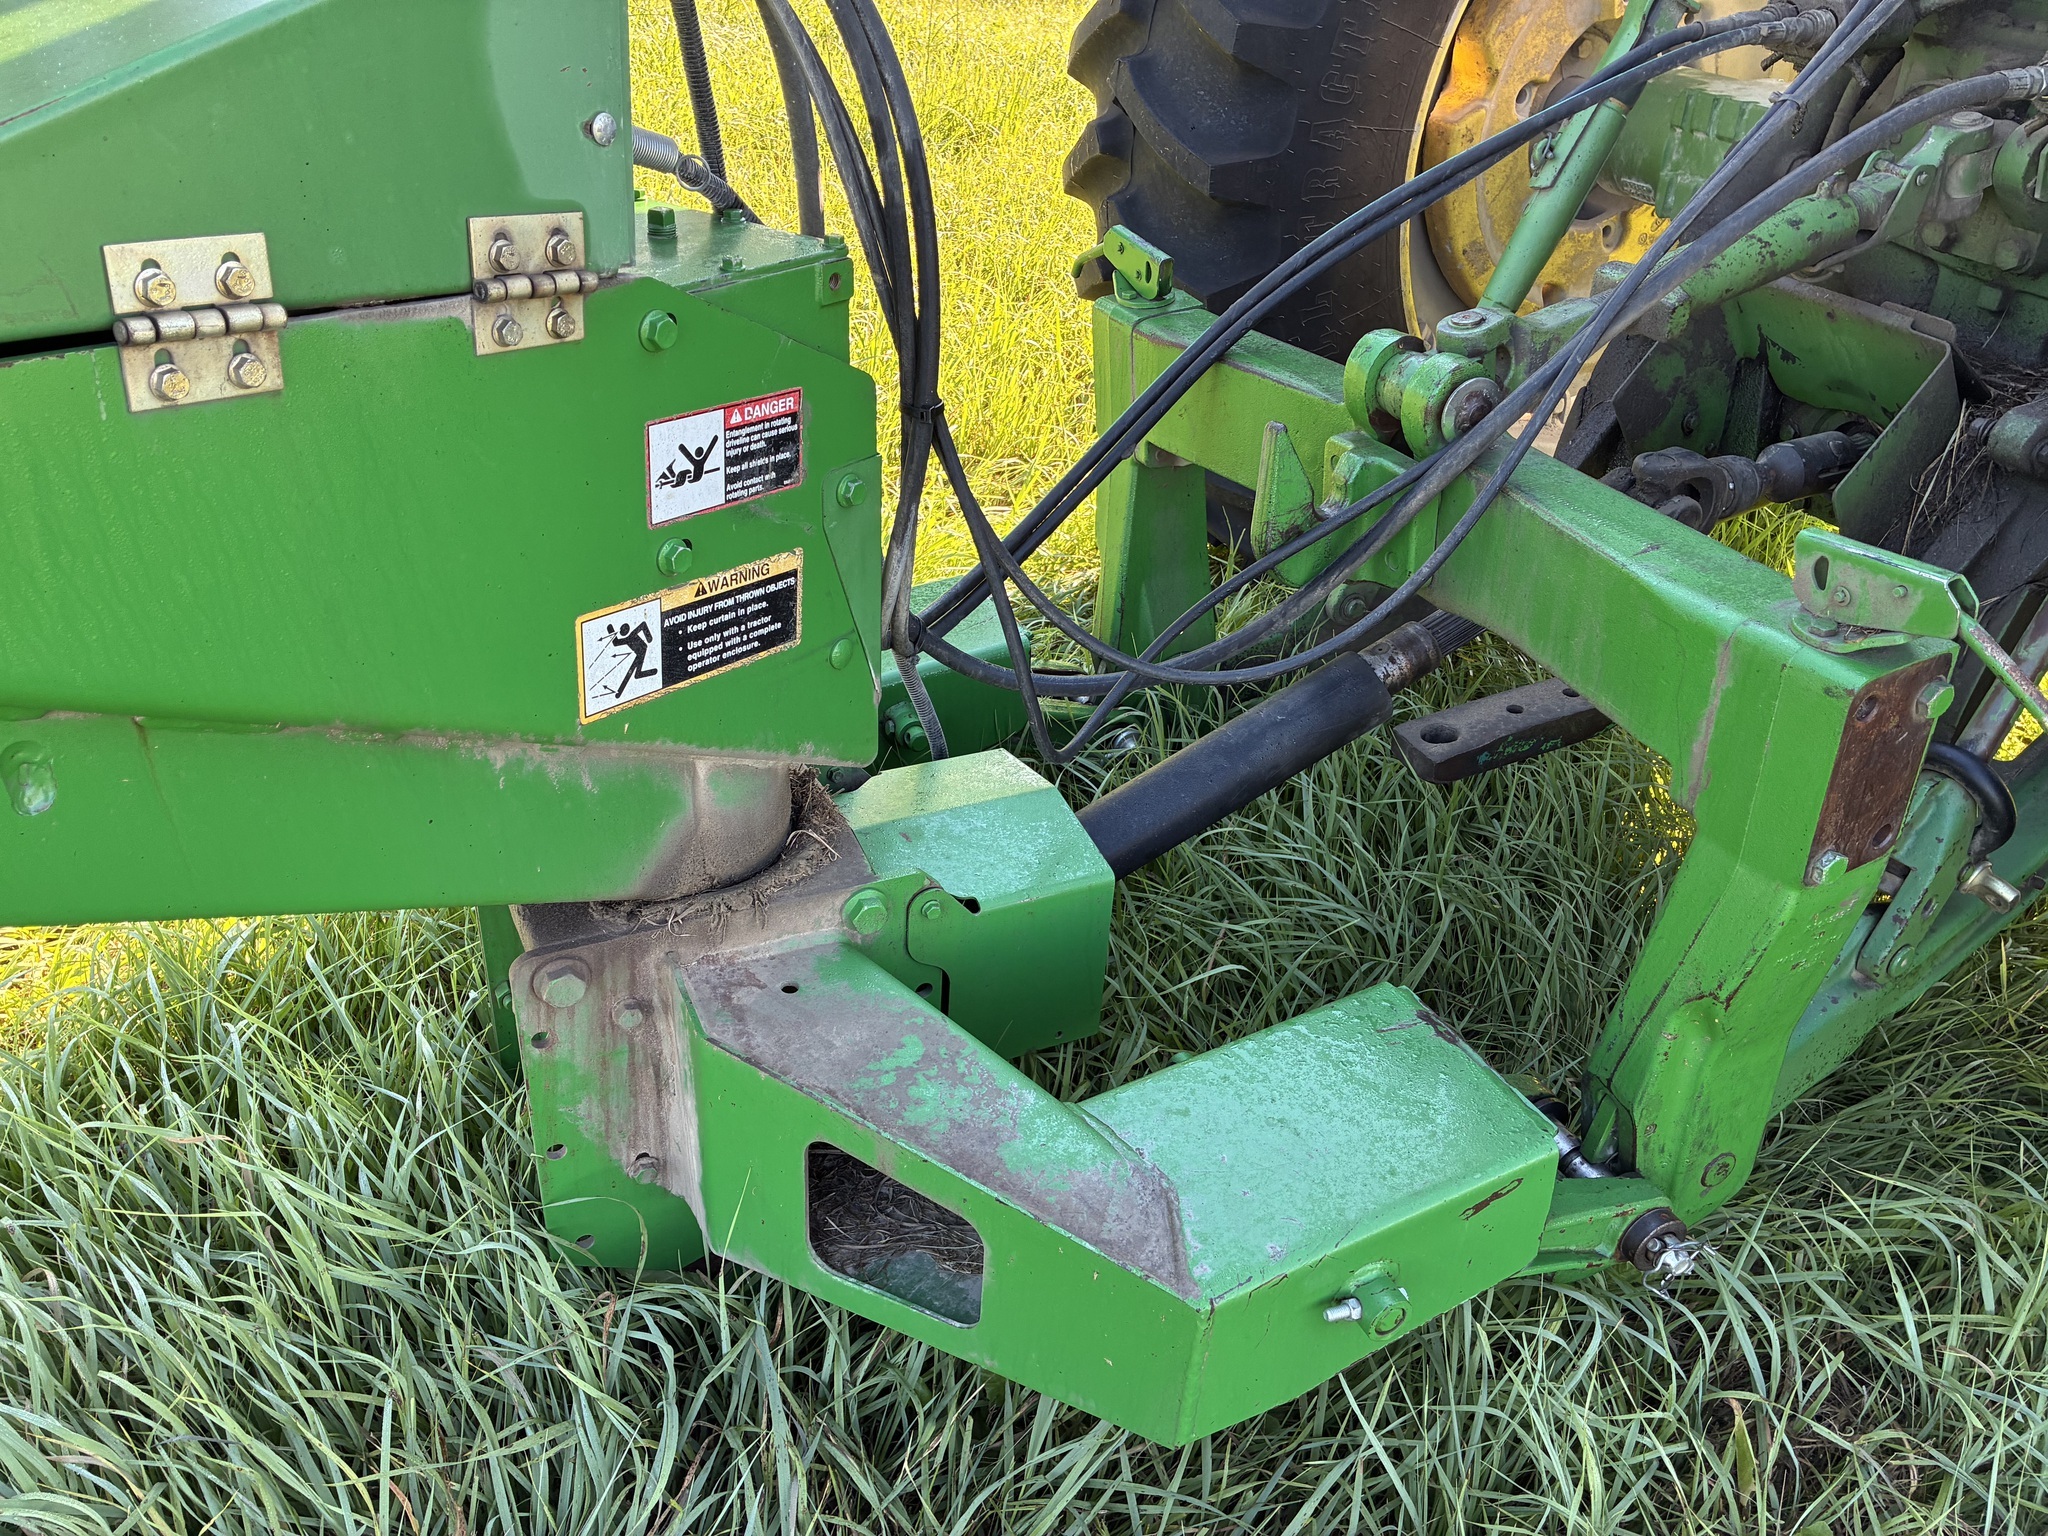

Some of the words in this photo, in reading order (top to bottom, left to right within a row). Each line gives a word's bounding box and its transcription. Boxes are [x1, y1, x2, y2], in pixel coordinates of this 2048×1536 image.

[1298, 0, 1381, 241] TRACT
[745, 397, 794, 420] DANGER
[726, 423, 763, 438] Entanglement
[765, 421, 770, 429] in
[771, 417, 791, 426] rotating
[726, 437, 749, 448] driveline
[762, 431, 777, 439] cause
[779, 424, 798, 434] serious
[726, 448, 742, 458] injury
[750, 440, 766, 450] death.
[726, 466, 740, 474] Keep
[750, 457, 768, 468] shields
[776, 452, 791, 462] place.
[726, 489, 747, 500] rotating
[749, 485, 764, 495] parts.
[727, 480, 742, 491] Avoid
[744, 475, 763, 486] contact
[765, 471, 776, 480] with
[708, 563, 769, 593] WARNING
[664, 614, 687, 628] AVOID
[688, 604, 713, 619] INJURY
[715, 597, 735, 611] FROM
[736, 587, 765, 604] THROWN
[766, 577, 795, 594] OBJECTS
[688, 622, 707, 634] Keep
[709, 611, 736, 625] curtain
[738, 608, 745, 618] in
[747, 601, 768, 617] place.
[687, 640, 702, 650] Use
[704, 633, 721, 645] only
[723, 626, 738, 637] with
[747, 615, 771, 628] tractor
[687, 642, 723, 661] equipped
[725, 636, 741, 648] with
[749, 622, 782, 638] complete
[688, 654, 720, 672] operator
[722, 640, 760, 659] enclosure.
